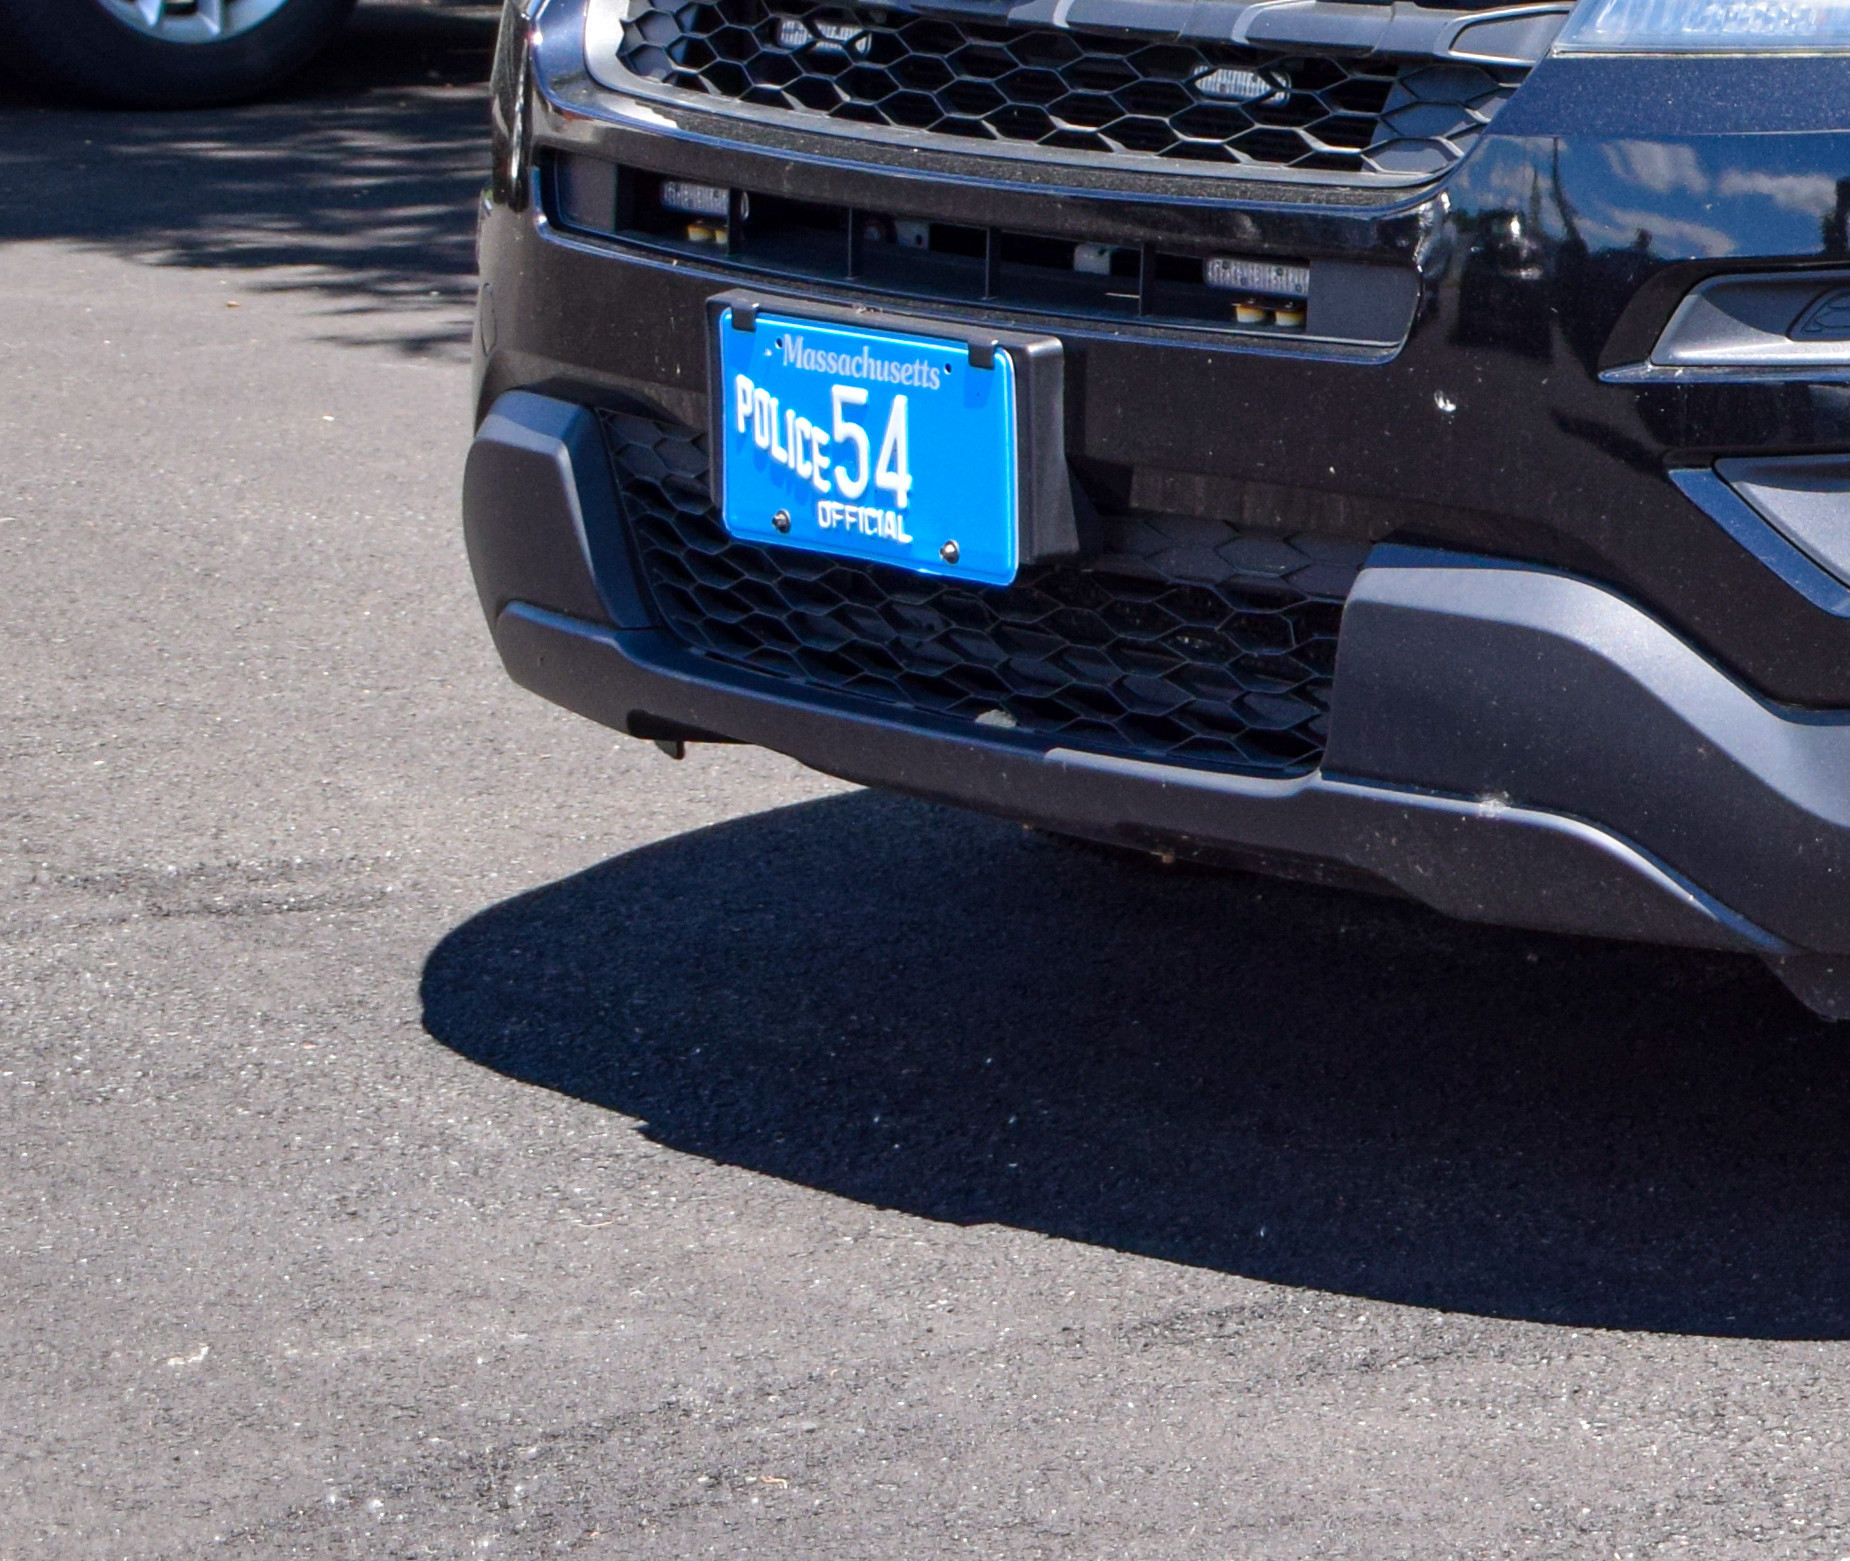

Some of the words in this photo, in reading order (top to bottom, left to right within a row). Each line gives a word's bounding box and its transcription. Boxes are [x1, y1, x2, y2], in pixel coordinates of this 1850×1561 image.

[783, 333, 942, 390] Massachusetts
[735, 373, 832, 493] POLICE
[831, 383, 914, 510] 54
[817, 499, 915, 544] OFFICIAL
